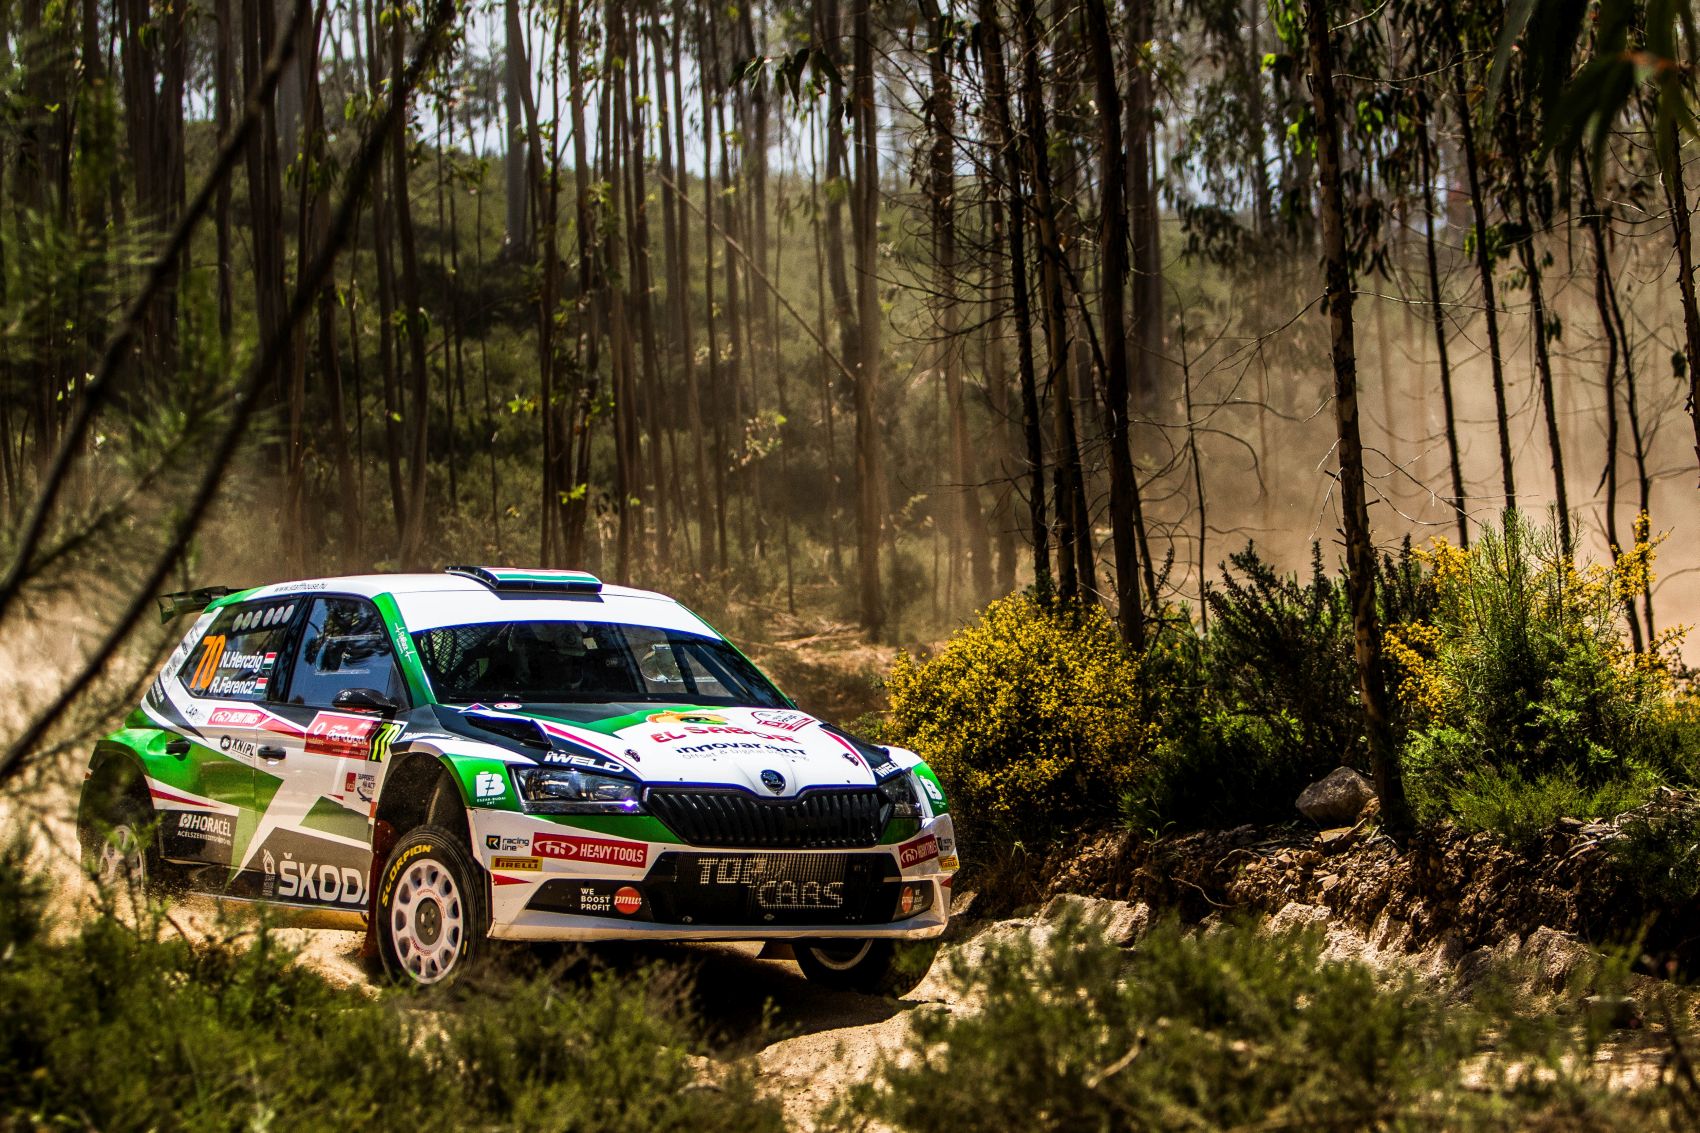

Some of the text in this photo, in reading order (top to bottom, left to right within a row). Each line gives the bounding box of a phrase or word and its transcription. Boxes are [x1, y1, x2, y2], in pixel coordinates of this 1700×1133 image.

[189, 634, 226, 689] 70
[219, 651, 264, 672] N.Herczig
[209, 676, 257, 695] R.Ferencz
[371, 723, 401, 761] 70
[651, 726, 803, 744] EL SABOR
[232, 738, 255, 757] KNIPL
[190, 811, 232, 838] HORACÉL
[502, 837, 530, 847] racing
[502, 844, 518, 852] line
[579, 843, 644, 863] HEAVY TOOLS
[495, 857, 538, 869] PIRELLI
[381, 844, 433, 908] SCORPION
[580, 887, 595, 895] WE
[580, 895, 611, 904] BOOST
[580, 903, 611, 911] PROFIT
